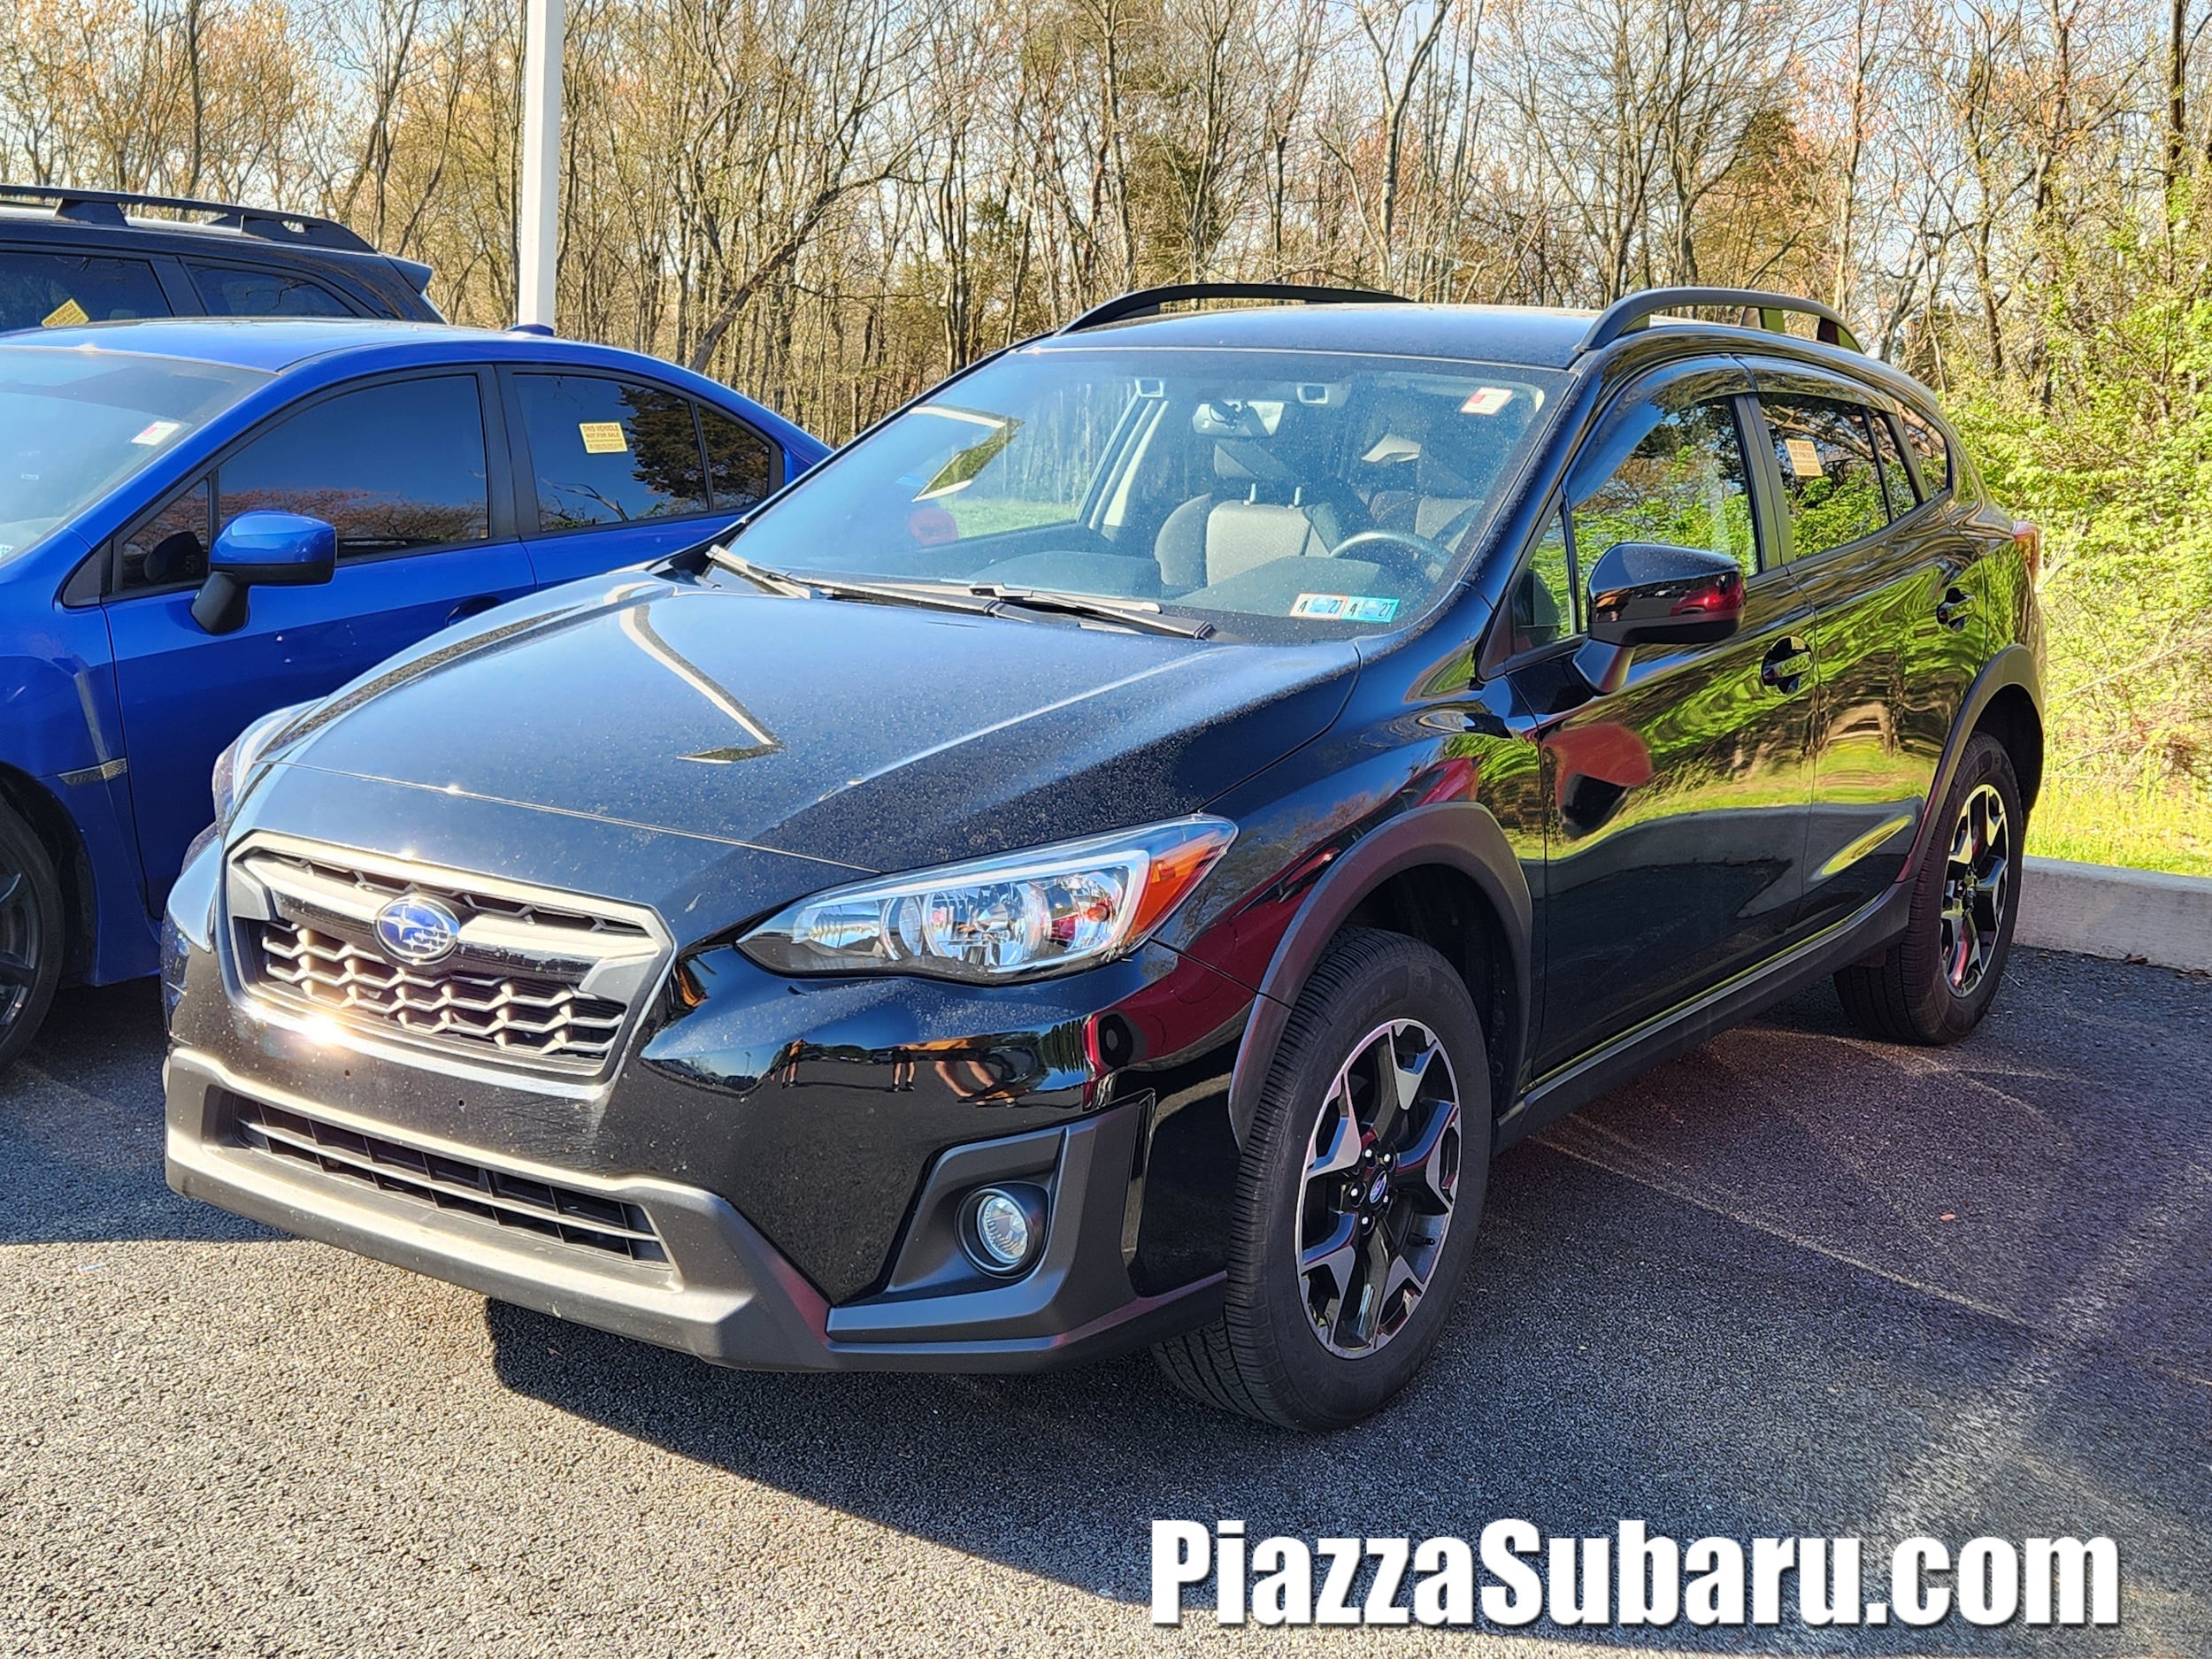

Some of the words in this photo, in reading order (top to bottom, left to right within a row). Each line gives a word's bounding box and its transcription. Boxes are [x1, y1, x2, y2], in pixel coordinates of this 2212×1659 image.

[1297, 601, 1309, 613] 4
[1328, 600, 1343, 614] 27
[1348, 603, 1358, 617] 4
[1379, 603, 1394, 617] 27
